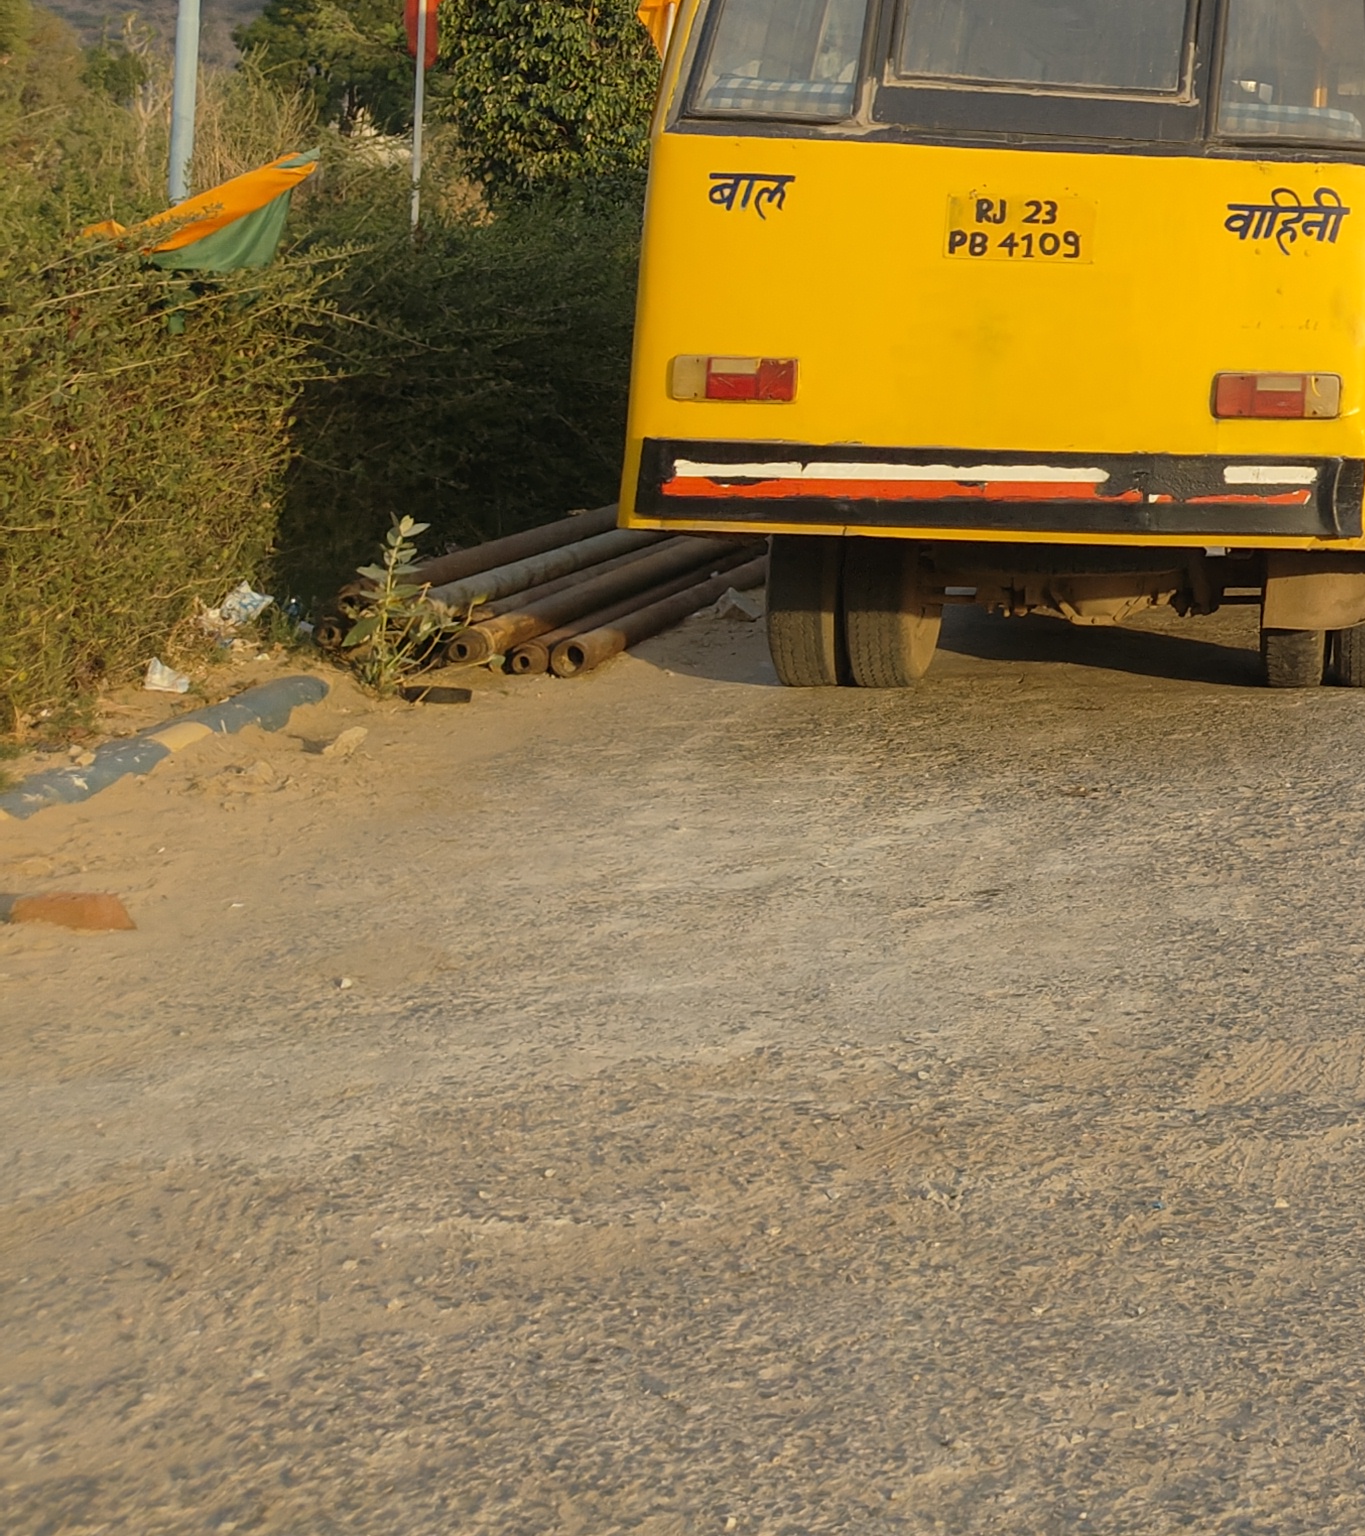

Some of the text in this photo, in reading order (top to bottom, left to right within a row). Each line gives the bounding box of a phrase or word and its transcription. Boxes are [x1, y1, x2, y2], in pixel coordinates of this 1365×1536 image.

[708, 172, 1351, 256] बाल वाहिनी
[975, 198, 1058, 225] RJ 23
[948, 229, 1082, 259] PB 4109
